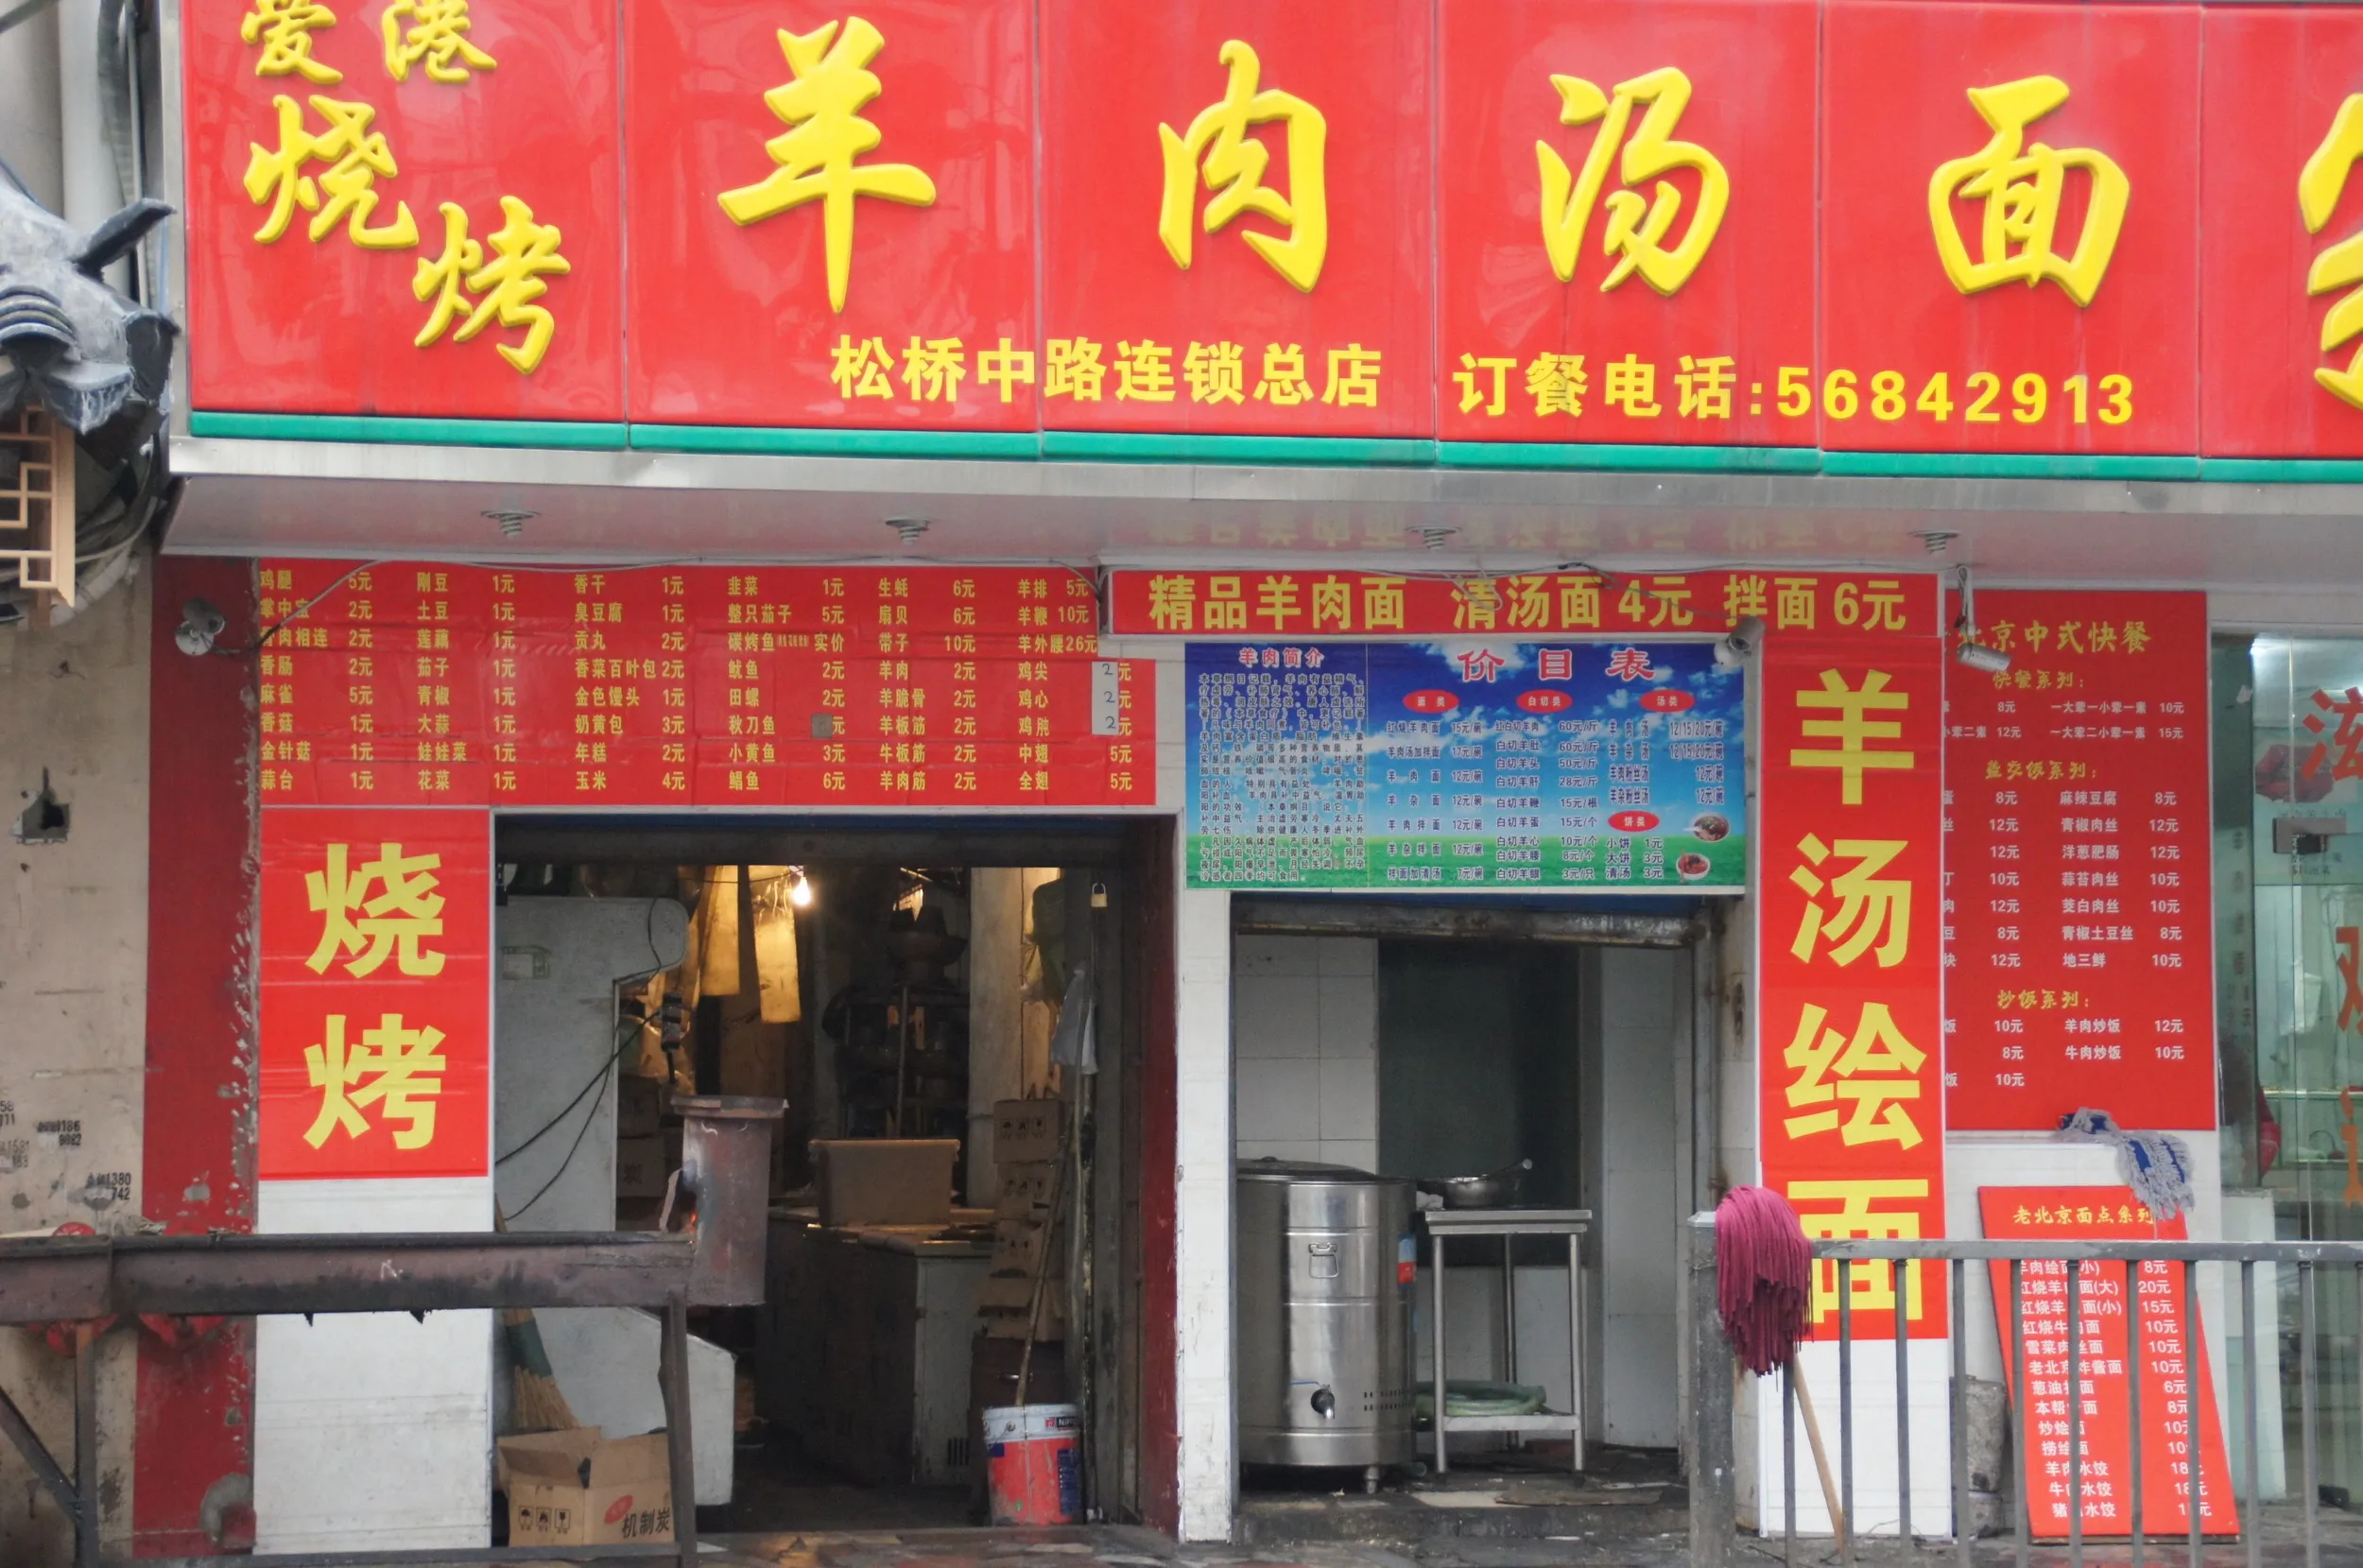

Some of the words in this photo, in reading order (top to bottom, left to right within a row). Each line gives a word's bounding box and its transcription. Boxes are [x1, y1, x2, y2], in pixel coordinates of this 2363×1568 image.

[244, 94, 571, 375] 烧烤
[831, 336, 1383, 407] 松桥中路连锁总店
[1453, 353, 2134, 424] 订餐电话:56842913
[493, 575, 514, 593] 1元
[575, 574, 605, 594] 香干
[728, 576, 757, 595] 韭菜
[1018, 579, 1047, 598] 羊排
[349, 600, 372, 619] 2元
[418, 601, 448, 620] 土豆
[1148, 576, 1407, 631] 精品羊肉面
[1451, 575, 1601, 629] 清汤面
[1618, 577, 1694, 628] 4元
[1723, 576, 1819, 626] 拌面
[1835, 578, 1906, 631] 6元
[728, 604, 791, 624] 整只茄子
[822, 606, 844, 624] 5元
[954, 607, 975, 625] 6元
[1059, 606, 1089, 625] 10元
[575, 630, 606, 650] 贡丸
[662, 632, 684, 651] 2元
[815, 633, 843, 652] 实价
[879, 632, 908, 652] 带子
[945, 635, 975, 652] 10元
[1066, 633, 1096, 653] 26元
[261, 655, 293, 675] 香肠
[418, 657, 449, 677] 茄子
[1240, 648, 1323, 667] 羊肉简介
[1457, 648, 1654, 681] 价目表
[880, 661, 907, 681] 羊肉
[1019, 662, 1047, 681] 鸡尖
[261, 683, 293, 703] 麻雀
[350, 686, 373, 705] 5元
[418, 685, 449, 705] 青椒
[576, 686, 639, 706] 金色馒头
[730, 688, 759, 707] 田螺
[1019, 689, 1048, 708] 鸡心
[1998, 701, 2015, 713] 8元
[2161, 702, 2184, 714] 10元
[261, 712, 293, 732] 香菇
[418, 714, 449, 734] 大蒜
[494, 715, 516, 734] 1元
[576, 715, 623, 735] 奶黄包
[663, 715, 684, 733] 3元
[729, 715, 775, 734] 秋刀鱼
[880, 715, 924, 735] 羊板筋
[1388, 721, 1440, 733] 红烧羊肉面
[1997, 727, 2021, 738] 12元
[2160, 728, 2182, 739] 15元
[261, 741, 311, 761] 金针菇
[418, 742, 466, 761] 娃娃菜
[576, 742, 606, 763] 年糕
[730, 743, 775, 763] 小黄鱼
[823, 744, 845, 762] 3元
[880, 743, 925, 763] 牛板筋
[1020, 744, 1048, 764] 中翅
[1496, 758, 1539, 769] 白切羊头
[261, 769, 293, 789] 蒜台
[352, 771, 373, 790] 1元
[419, 770, 449, 790] 花菜
[576, 770, 606, 790] 玉米
[663, 771, 685, 790] 4元
[823, 772, 845, 790] 6元
[880, 771, 925, 790] 羊肉筋
[1020, 771, 1048, 790] 全翅
[1111, 772, 1132, 791] 5元
[1388, 770, 1440, 783] 羊肉面
[1496, 776, 1539, 787] 白切羊肝
[1388, 794, 1440, 806] 羊杂面
[2061, 790, 2116, 805] 麻辣豆腐
[2155, 792, 2176, 805] 8元
[1388, 818, 1440, 830] 羊肉拌面
[2061, 818, 2117, 832] 青椒肉丝
[2149, 818, 2179, 832] 12元
[1388, 843, 1440, 854] 羊杂拌面
[1496, 836, 1539, 847] 白切羊心
[1607, 837, 1630, 849] 小饼
[1645, 838, 1664, 849] 1元
[1607, 853, 1630, 864] 大饼
[1645, 853, 1664, 864] 3元
[2063, 845, 2118, 859] 洋葱肥肠
[1388, 868, 1440, 879] 拌面加清汤
[1607, 868, 1630, 879] 清汤
[2150, 872, 2180, 886] 10元
[2062, 899, 2119, 913] 茭白肉丝
[2062, 925, 2133, 940] 青椒土豆丝
[2063, 953, 2105, 967] 地三鲜
[303, 842, 447, 1150] 烧烤
[1784, 668, 1929, 1320] 羊汤绘面
[2065, 1019, 2120, 1033] 羊肉炒饭
[2155, 1020, 2183, 1032] 12元
[2065, 1045, 2121, 1060] 牛肉炒饭
[2155, 1046, 2184, 1060] 10元
[2138, 1281, 2170, 1294] 20元
[2022, 1301, 2121, 1315] 红烧羊面(小)
[2143, 1301, 2174, 1313] 15元
[2146, 1321, 2178, 1334] 10元
[2151, 1361, 2183, 1373] 10元
[2165, 1381, 2187, 1395] 6元
[2052, 1502, 2116, 1518] 猪水饺
